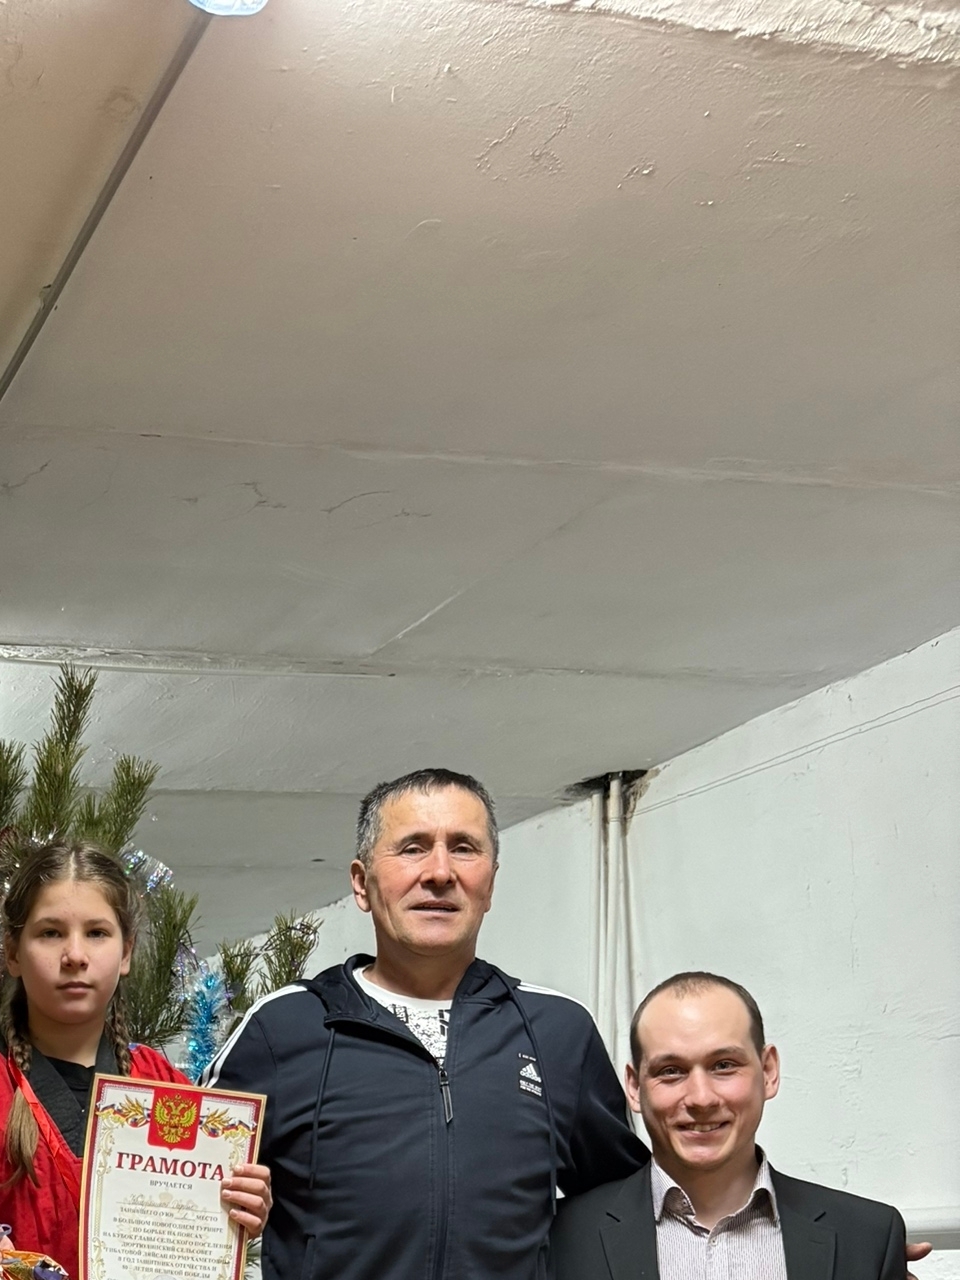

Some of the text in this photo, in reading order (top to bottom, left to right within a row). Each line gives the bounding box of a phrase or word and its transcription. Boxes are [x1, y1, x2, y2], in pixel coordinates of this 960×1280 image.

[115, 1151, 226, 1182] ГРАМОТА
[150, 1180, 193, 1190] ВРУЧАЕТСЯ
[196, 1215, 218, 1223] МЕСТО
